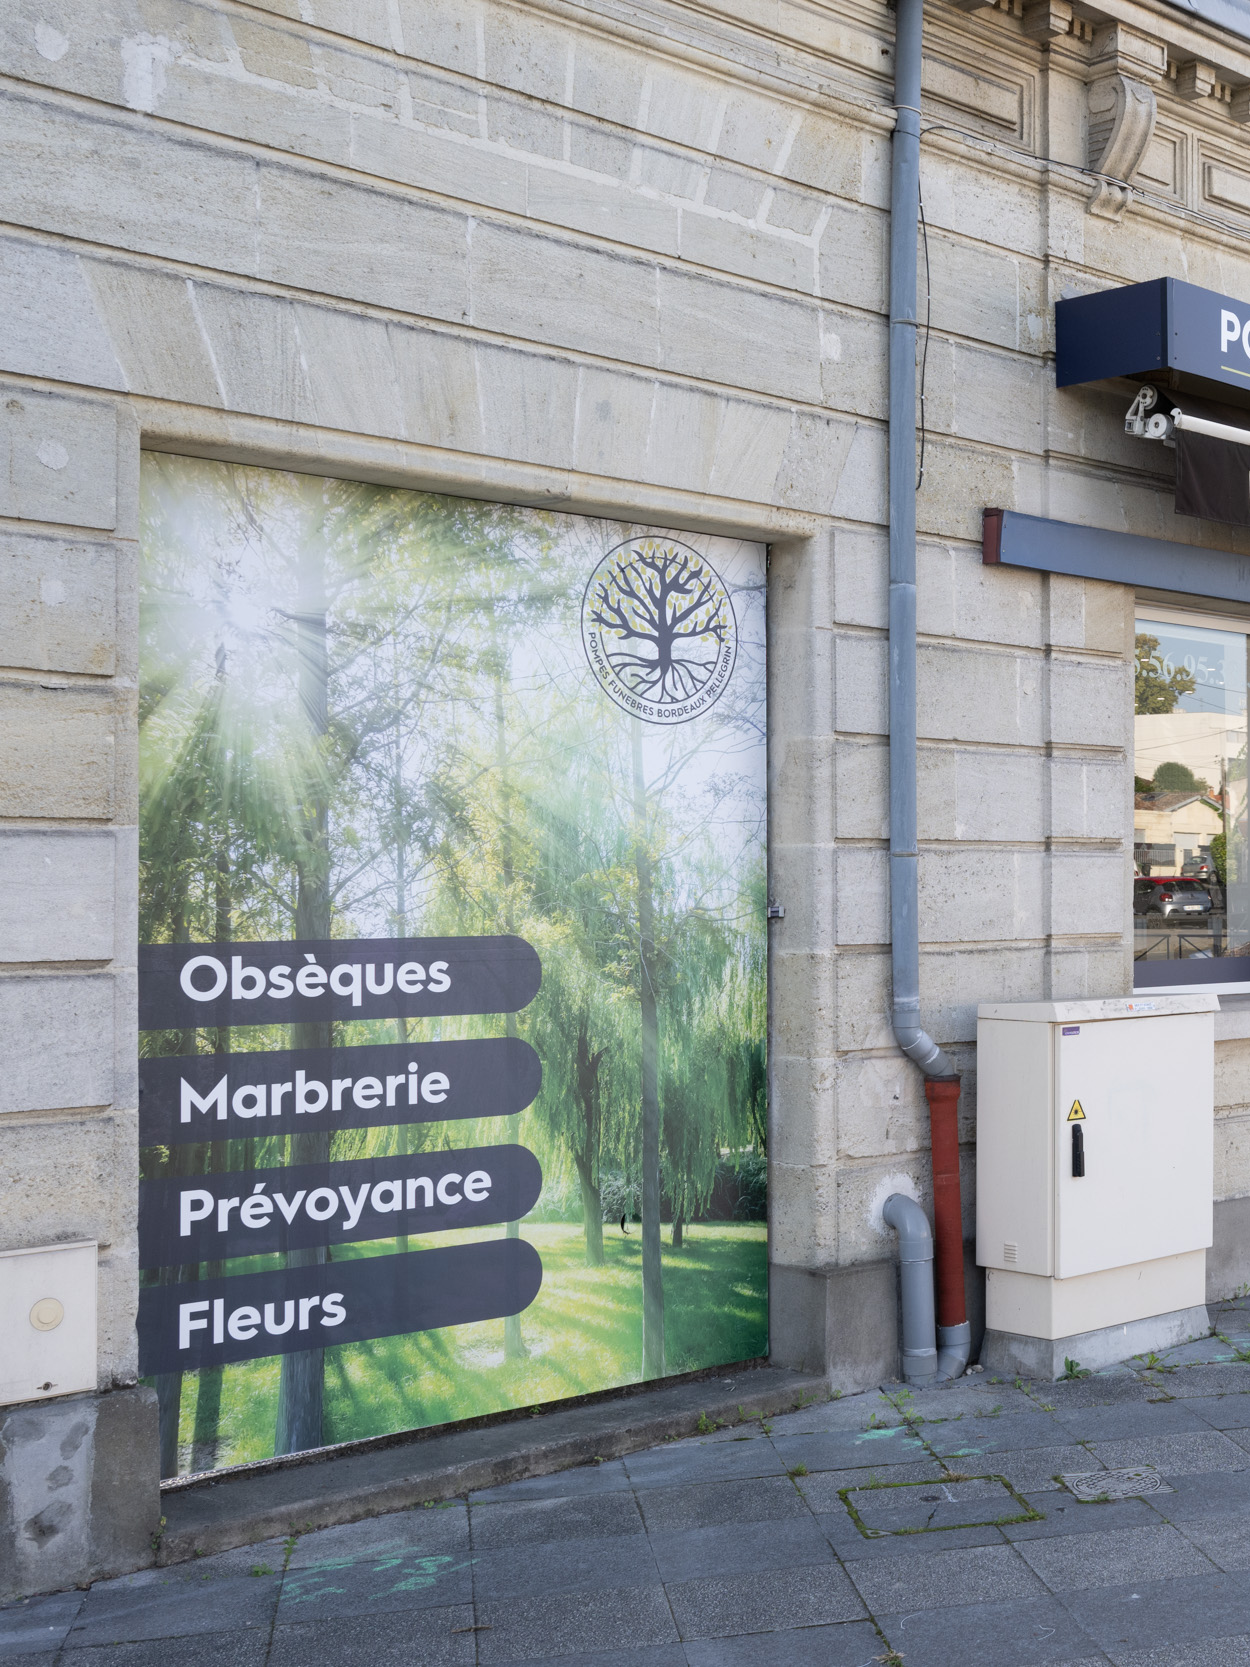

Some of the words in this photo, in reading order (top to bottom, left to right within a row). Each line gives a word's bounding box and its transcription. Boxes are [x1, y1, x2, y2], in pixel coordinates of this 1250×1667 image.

[588, 632, 611, 680] POMPES
[608, 679, 655, 717] FUNEBRES
[657, 694, 708, 719] BORDEAUX
[705, 645, 732, 699] PELLEGRIN
[179, 953, 453, 1007] Obsèques
[179, 1061, 451, 1124] Marbrerie
[178, 1169, 493, 1238] Prévoyance
[178, 1291, 348, 1351] Fleurs
